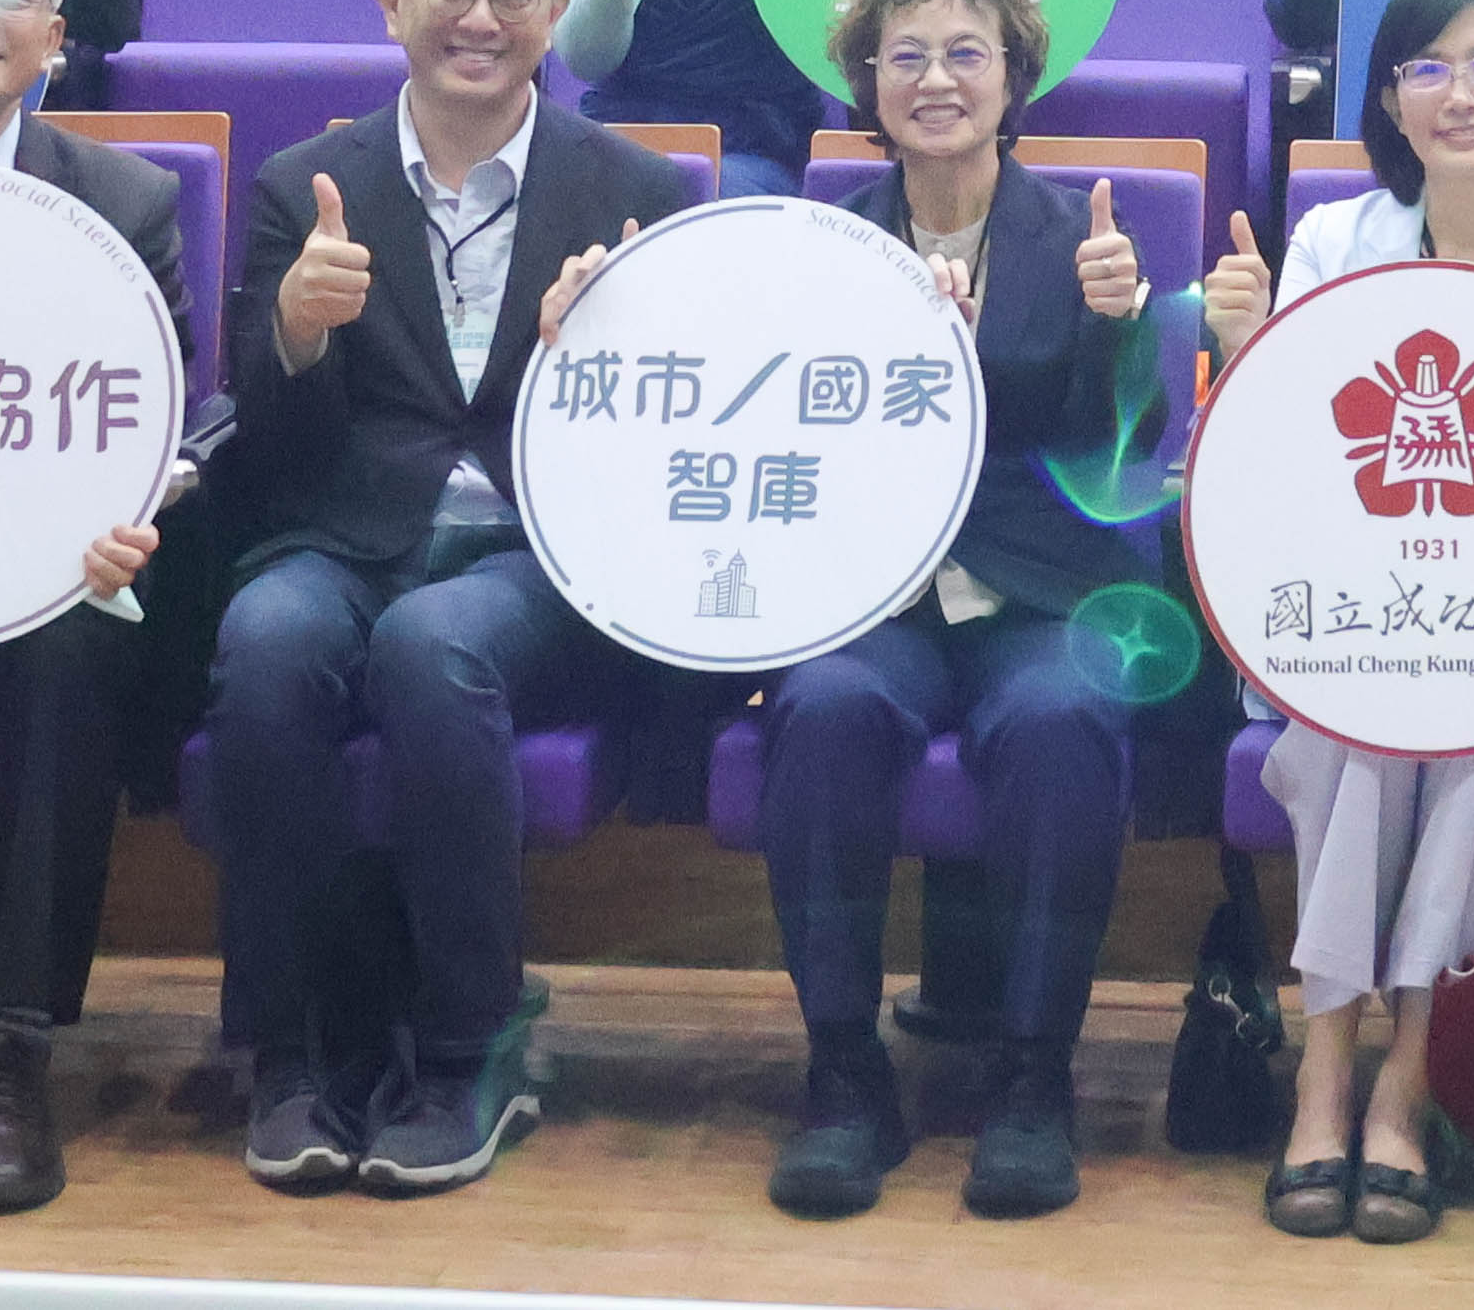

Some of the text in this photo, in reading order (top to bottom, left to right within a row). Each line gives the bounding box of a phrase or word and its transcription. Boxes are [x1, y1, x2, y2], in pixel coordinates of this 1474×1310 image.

[61, 204, 139, 283] Sciences
[805, 206, 876, 246] Social
[666, 449, 822, 525] 智庫
[1399, 538, 1460, 561] 1931
[1265, 654, 1352, 675] National
[1357, 654, 1422, 678] Cheng
